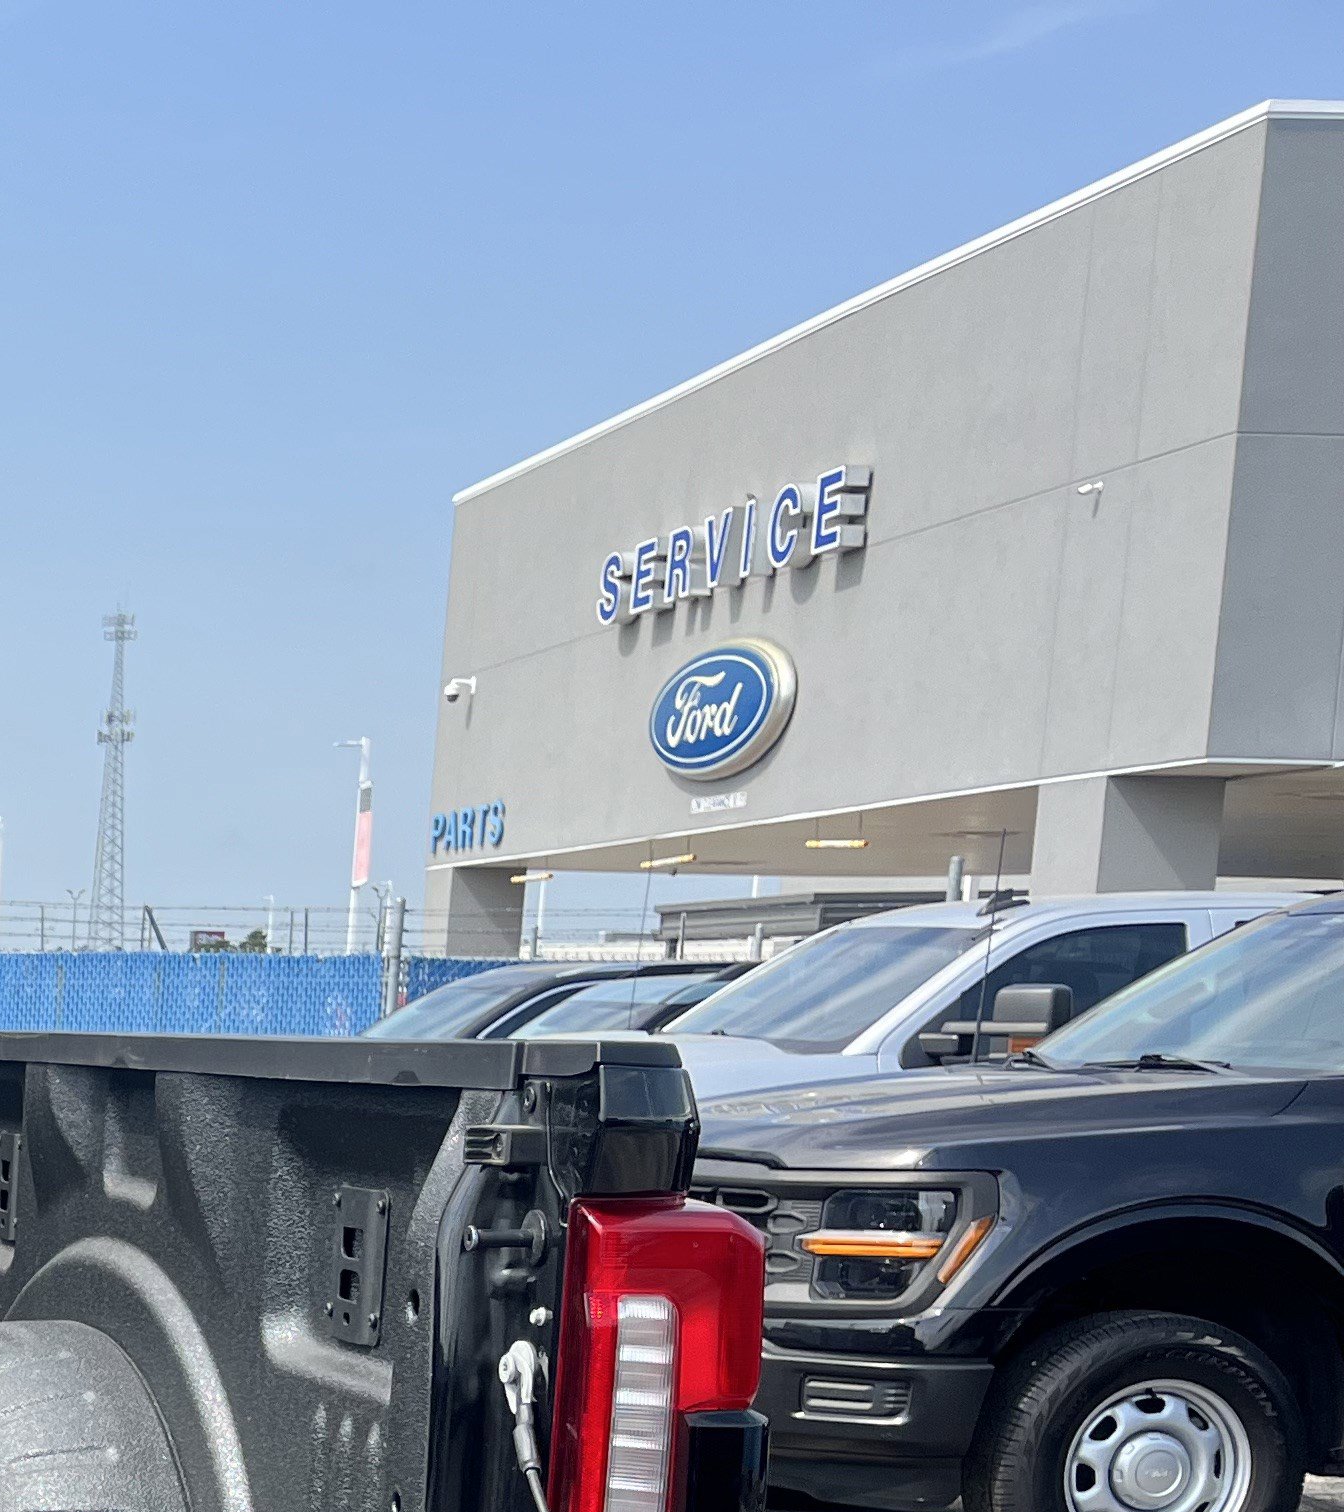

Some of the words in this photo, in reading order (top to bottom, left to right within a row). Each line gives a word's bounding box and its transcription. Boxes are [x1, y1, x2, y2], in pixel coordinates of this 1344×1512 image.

[596, 465, 852, 626] SERVICE
[666, 671, 744, 748] Ford
[431, 799, 506, 855] PARTS
